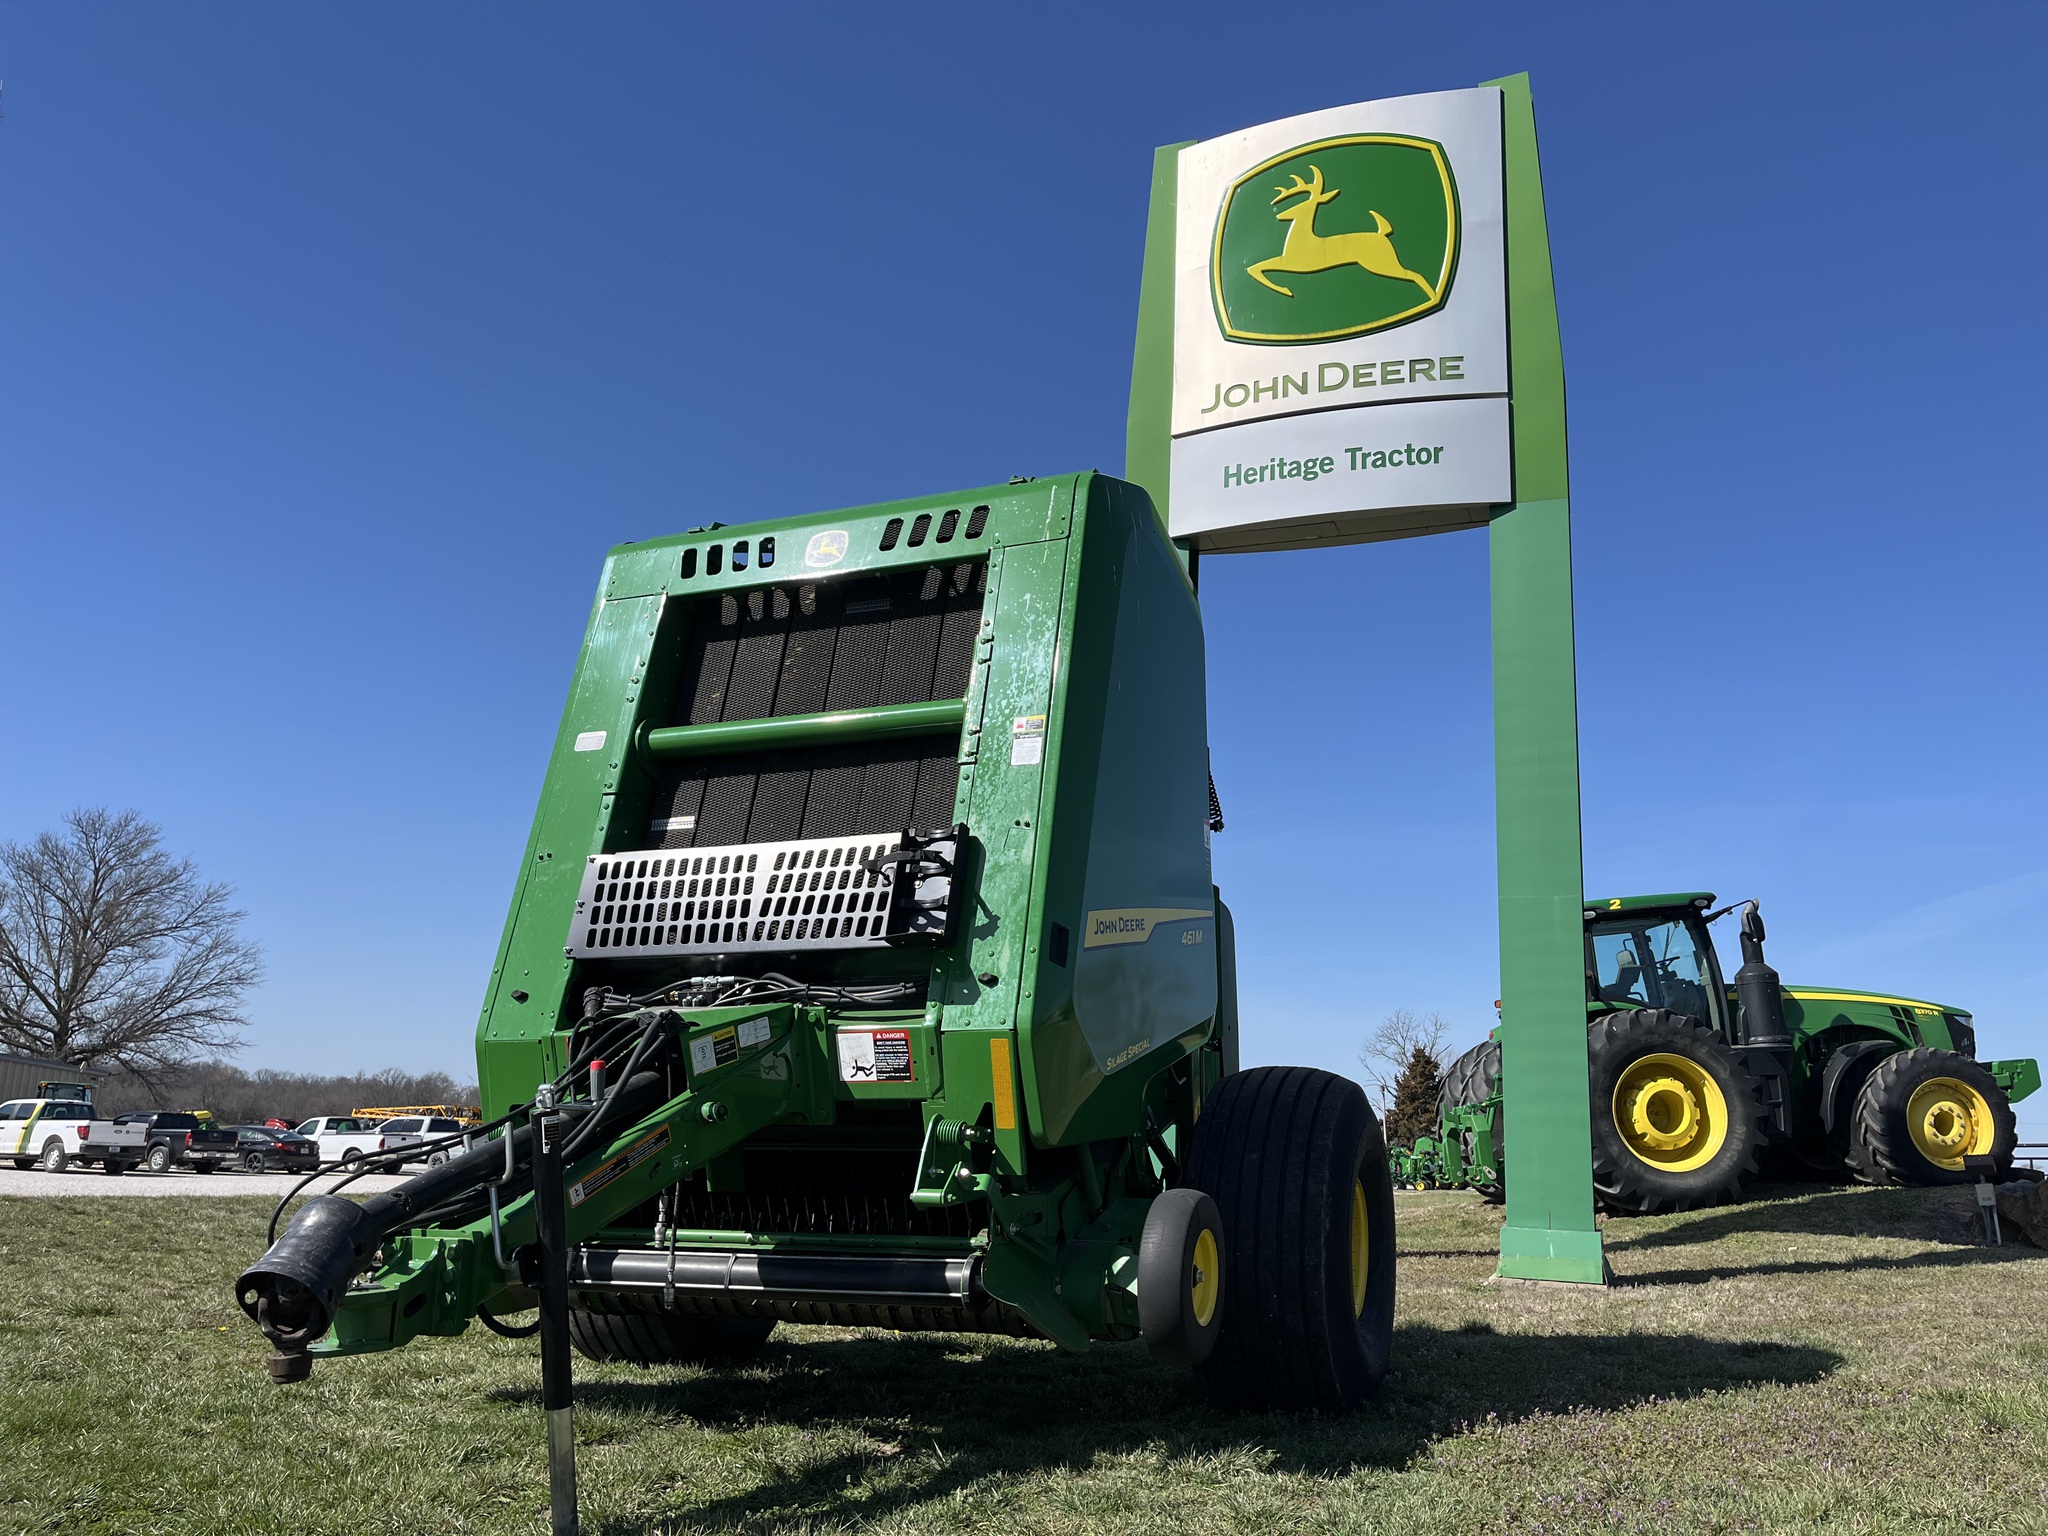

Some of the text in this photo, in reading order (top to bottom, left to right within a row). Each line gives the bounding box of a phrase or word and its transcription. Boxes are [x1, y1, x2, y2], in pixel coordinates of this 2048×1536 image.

[1201, 356, 1465, 414] JOHN DEERE
[1223, 443, 1444, 489] Heritage Tractor
[1609, 898, 1621, 910] 2
[1094, 917, 1145, 935] JOHN DEERE
[1106, 1038, 1150, 1070] SILAGE SPECIAL
